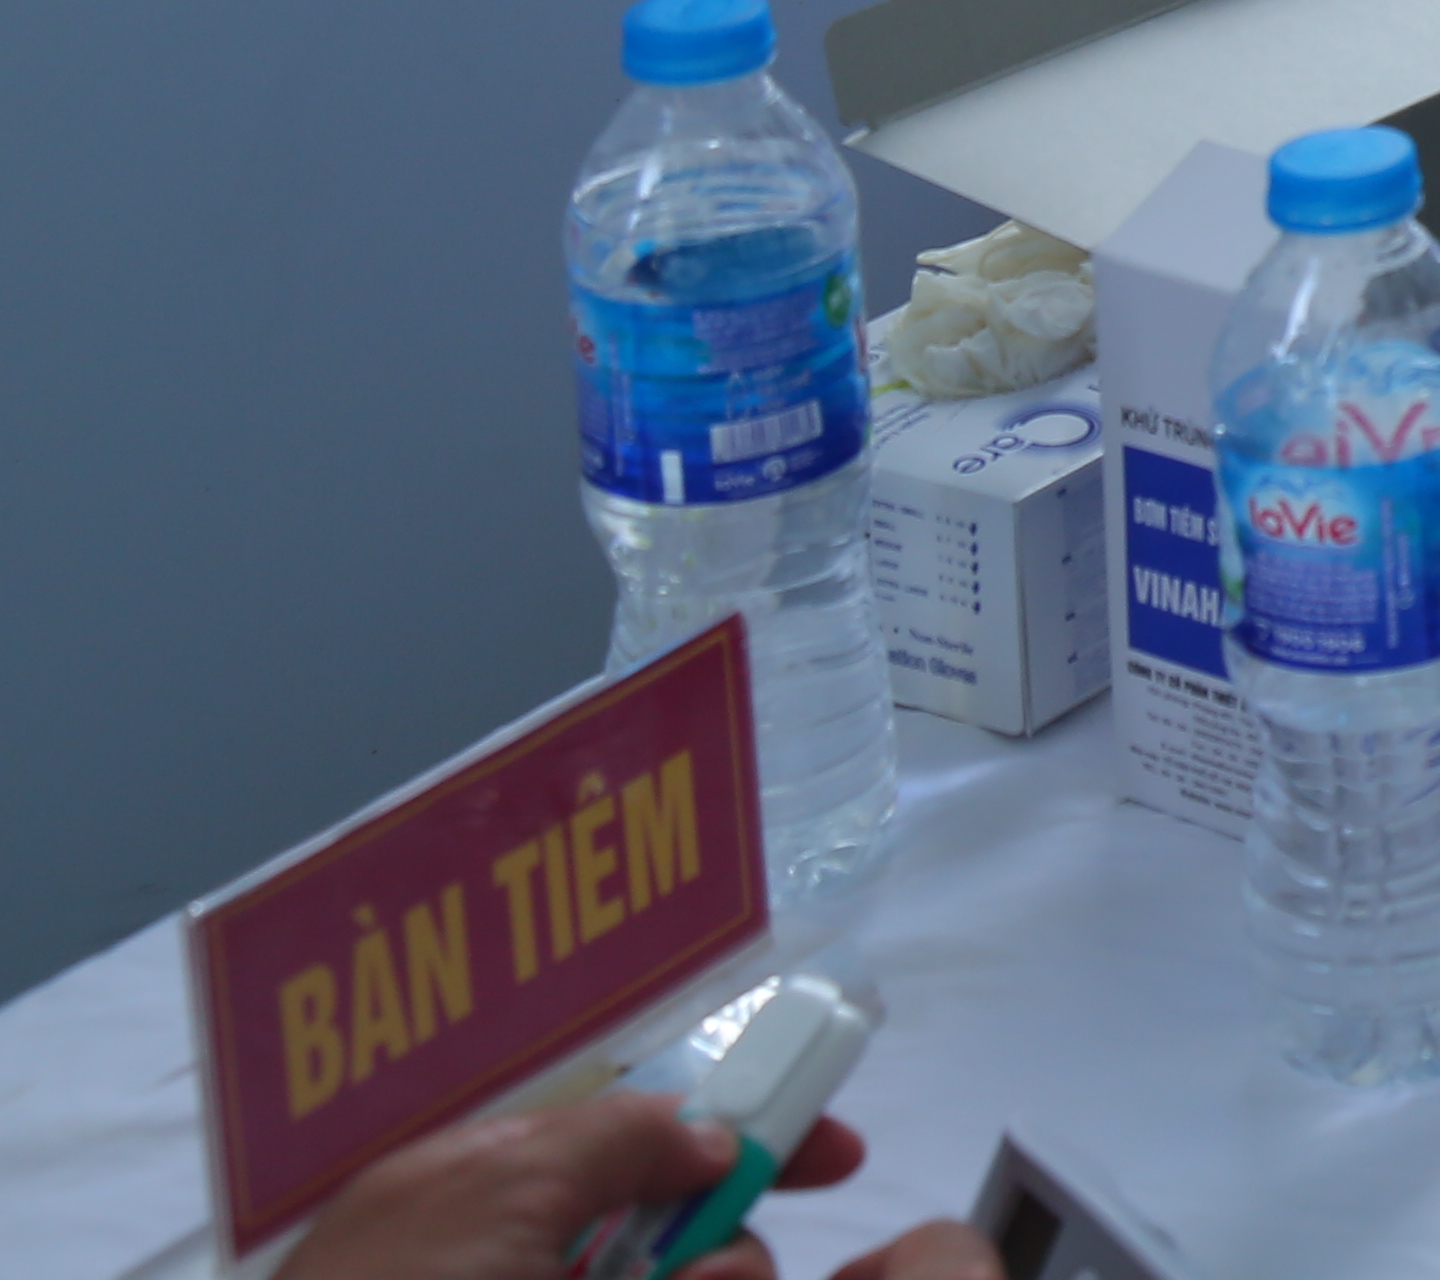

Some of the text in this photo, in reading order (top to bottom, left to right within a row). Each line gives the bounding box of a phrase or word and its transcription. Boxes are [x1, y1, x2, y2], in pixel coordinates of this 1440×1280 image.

[1120, 404, 1212, 449] KHỬ TRÙN
[1132, 563, 1223, 628] VINAH
[278, 747, 701, 1123] BÀN TIÊM
